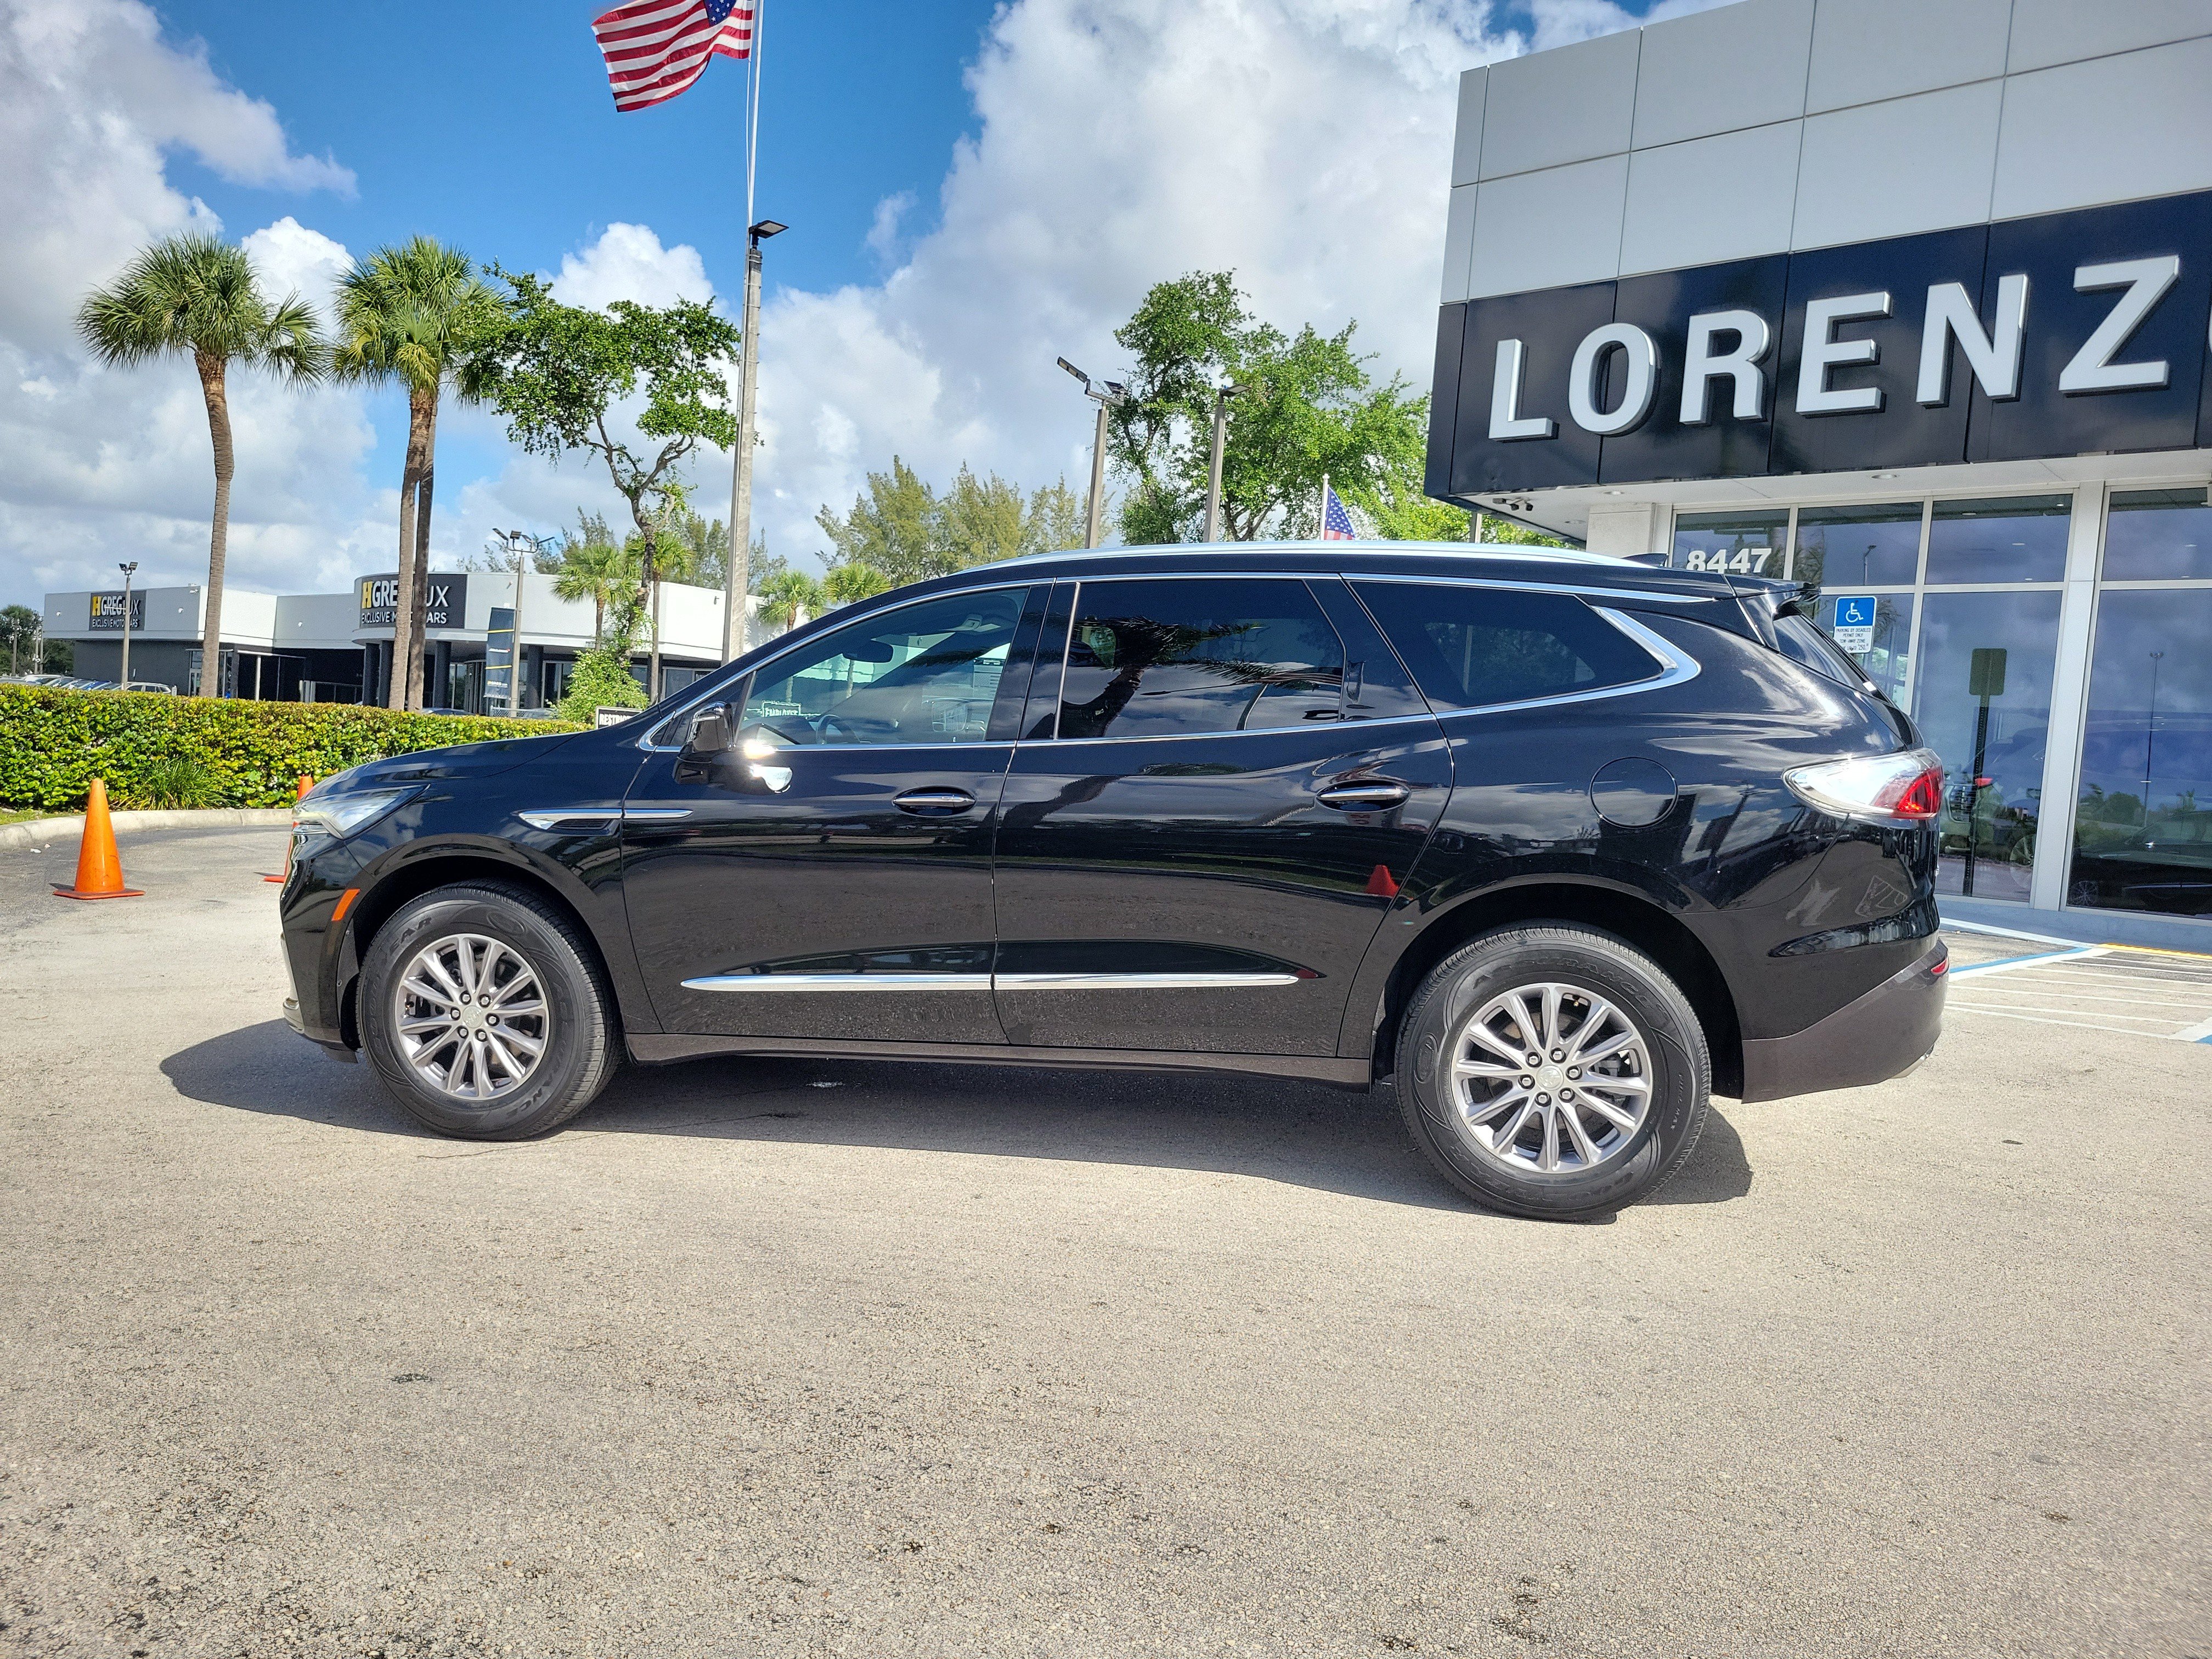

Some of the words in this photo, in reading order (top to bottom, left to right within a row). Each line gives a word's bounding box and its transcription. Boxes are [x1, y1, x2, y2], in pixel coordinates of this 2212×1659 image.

[1488, 255, 2212, 441] LORENZ
[1686, 549, 1772, 574] 8447
[362, 611, 390, 624] EXCLUSIVE
